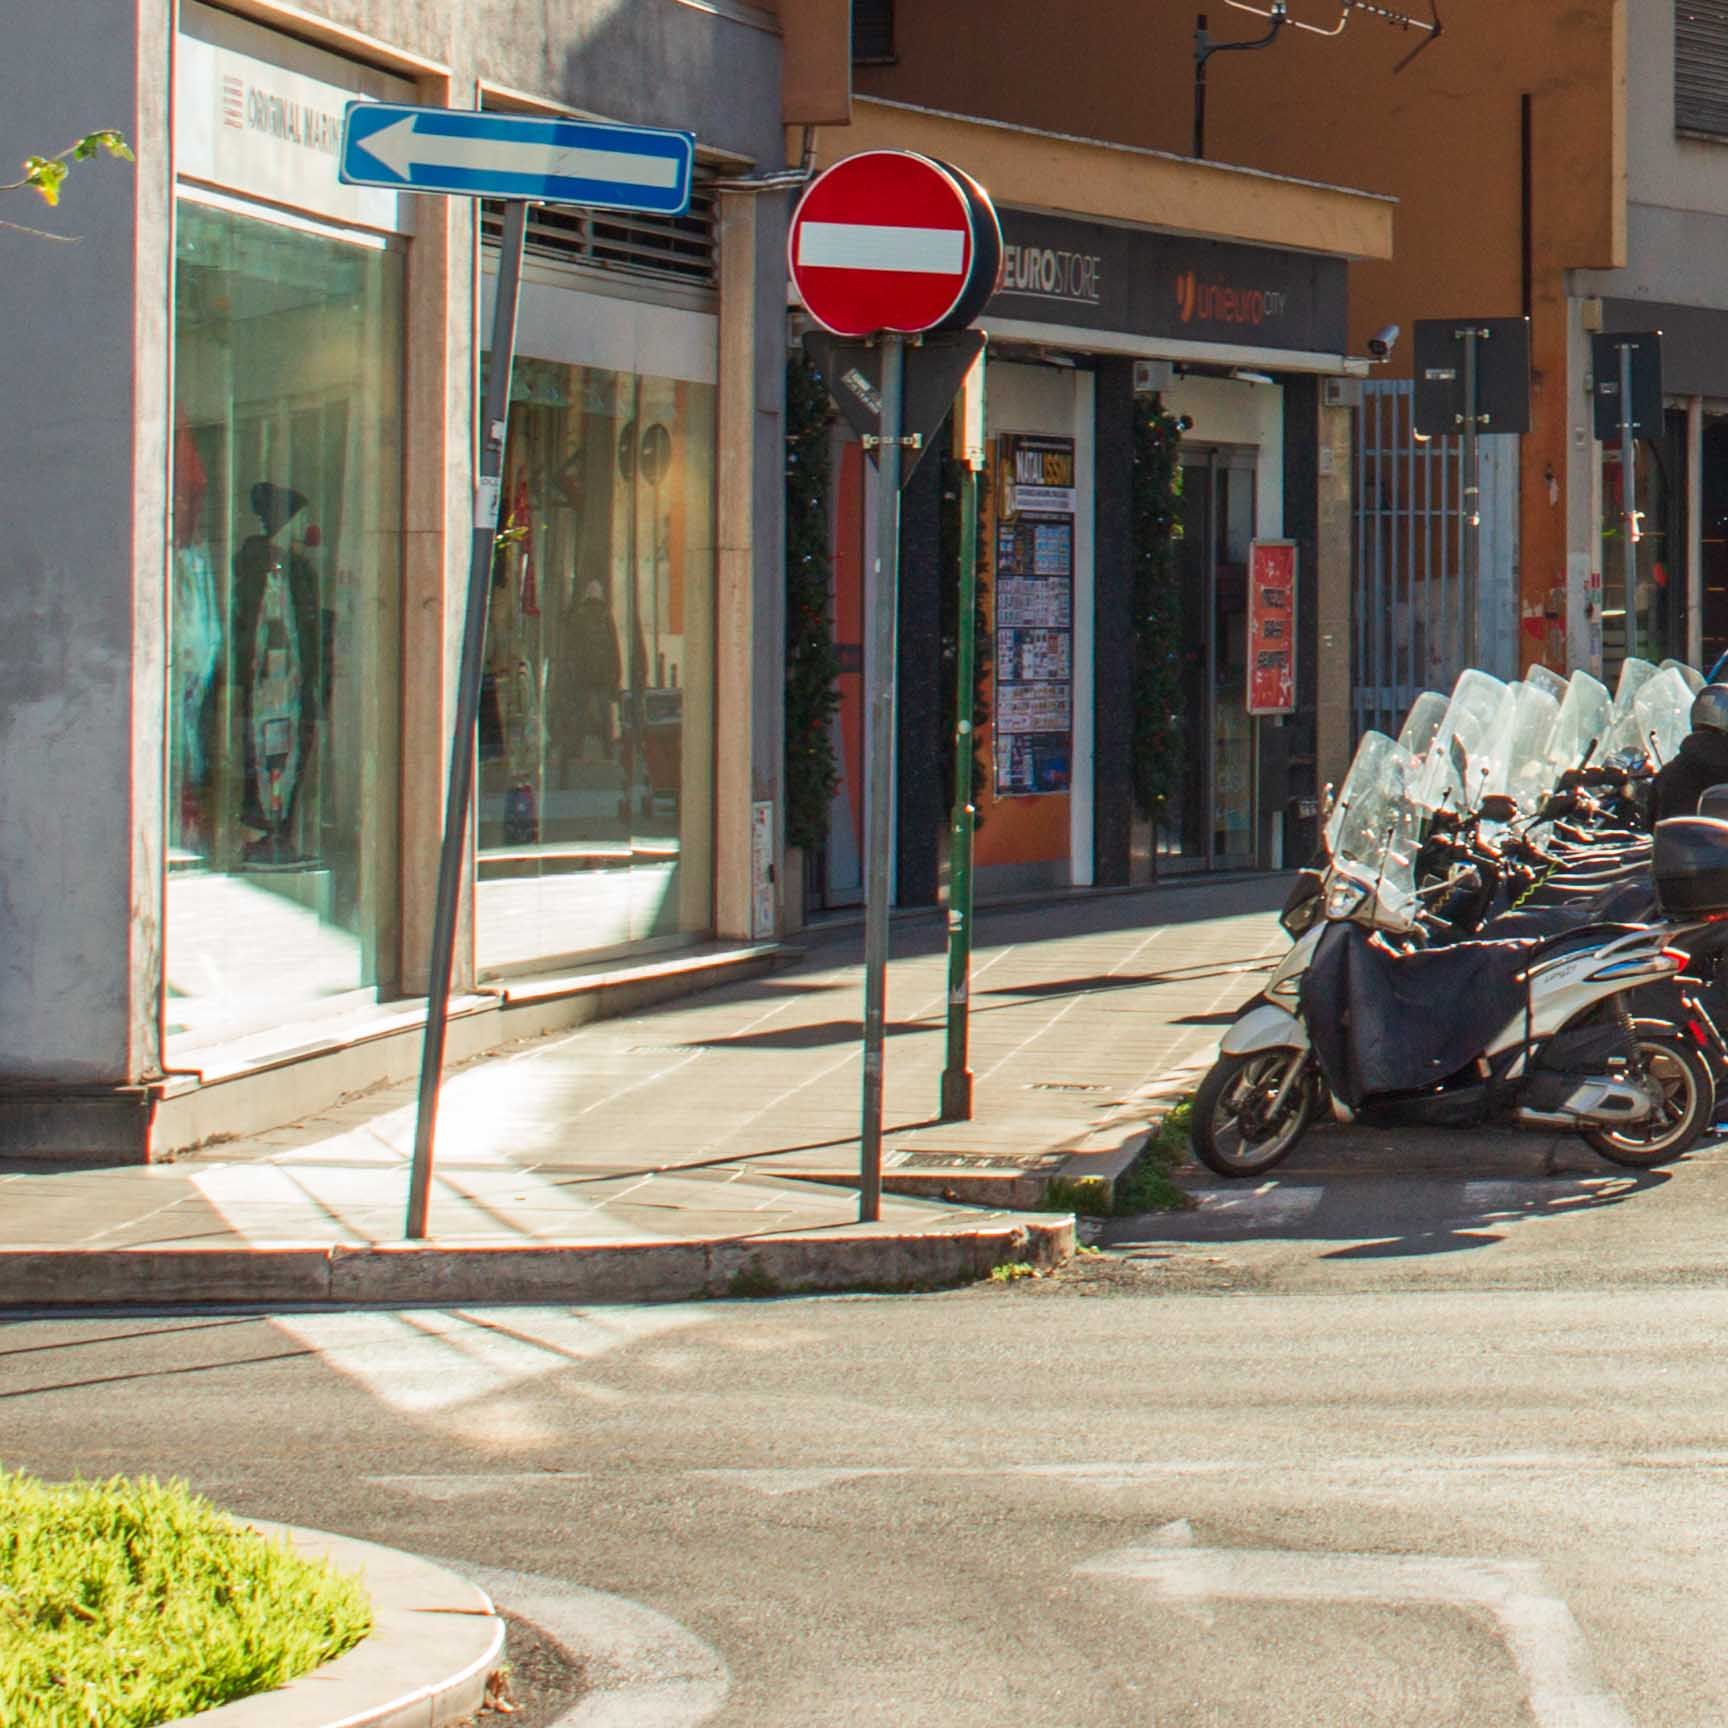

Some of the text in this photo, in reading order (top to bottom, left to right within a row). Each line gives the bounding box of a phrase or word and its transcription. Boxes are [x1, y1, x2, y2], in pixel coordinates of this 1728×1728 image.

[247, 85, 340, 153] ORIGINAL MARIN
[1198, 276, 1264, 324] unieuro
